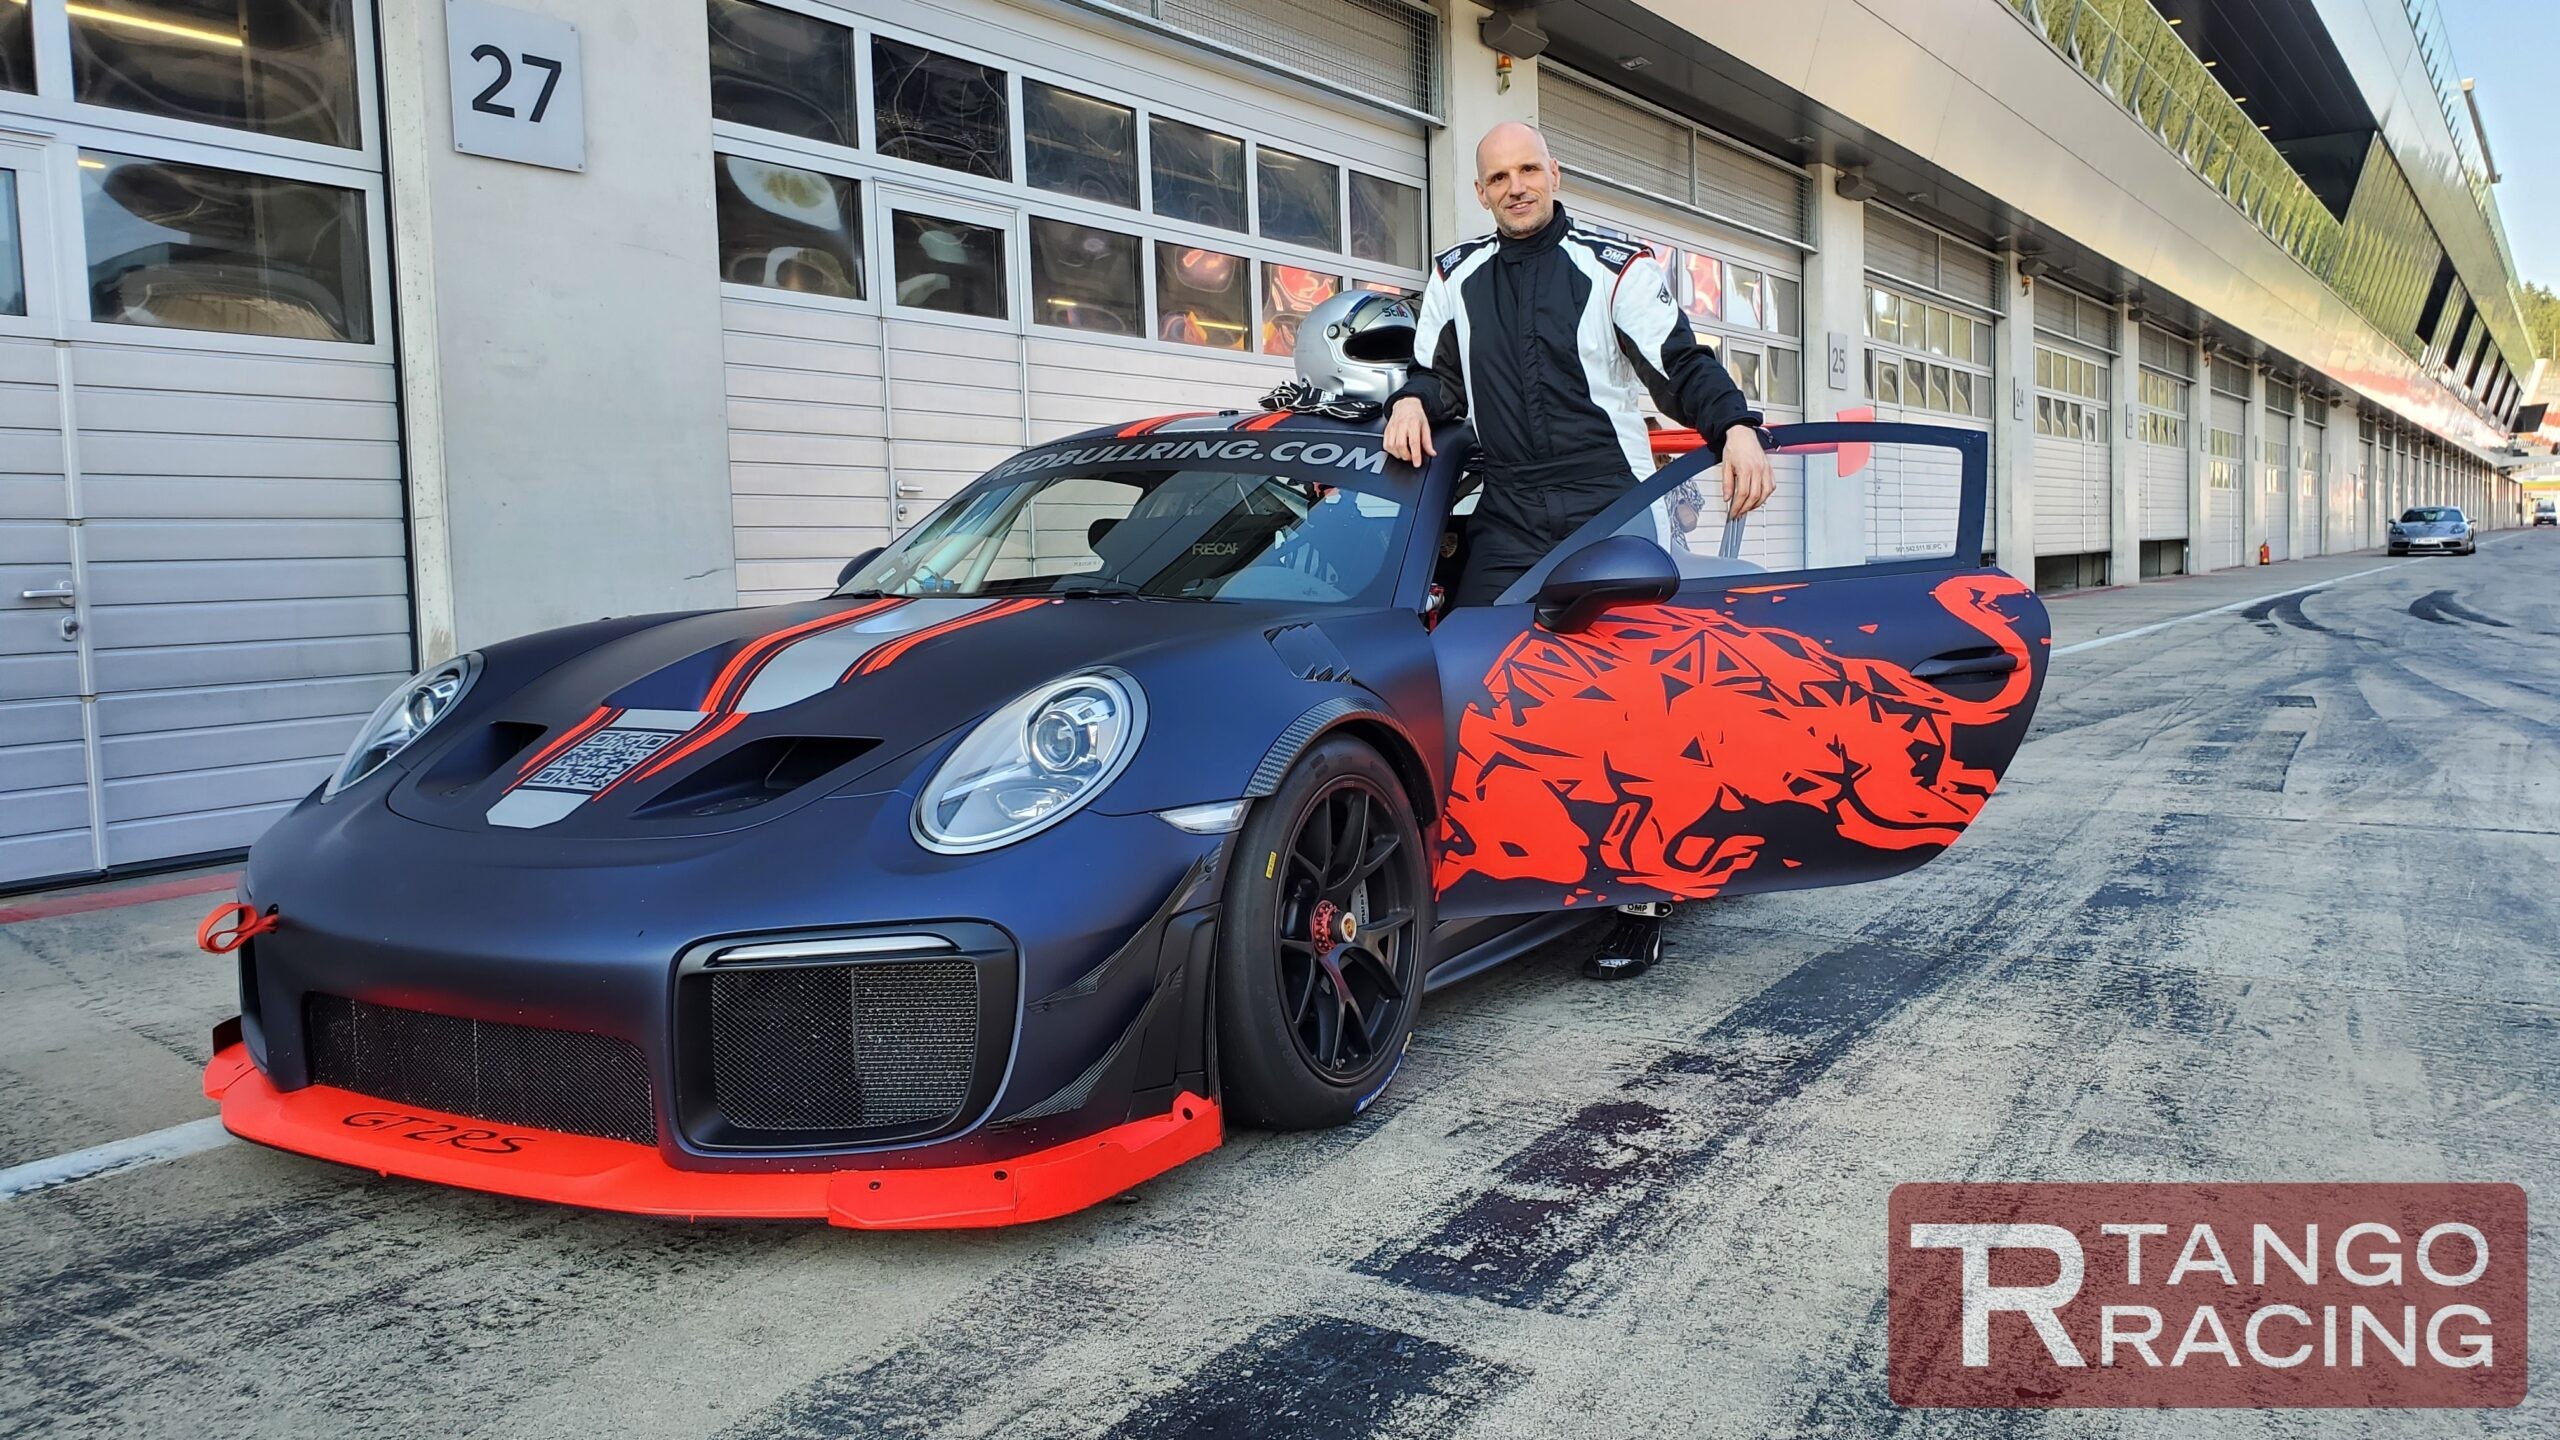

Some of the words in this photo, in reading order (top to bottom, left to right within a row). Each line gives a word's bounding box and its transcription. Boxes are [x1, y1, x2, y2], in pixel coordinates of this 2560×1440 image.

[470, 44, 562, 123] 27
[1442, 249, 1461, 270] OMP
[1601, 247, 1628, 263] OMP
[1660, 285, 1670, 304] OM
[1832, 347, 1846, 374] 25
[2016, 388, 2024, 409] 24
[982, 439, 1389, 485] REDBULLRING.COM
[1627, 903, 1648, 912] OMP
[342, 1112, 537, 1154] GT2RS
